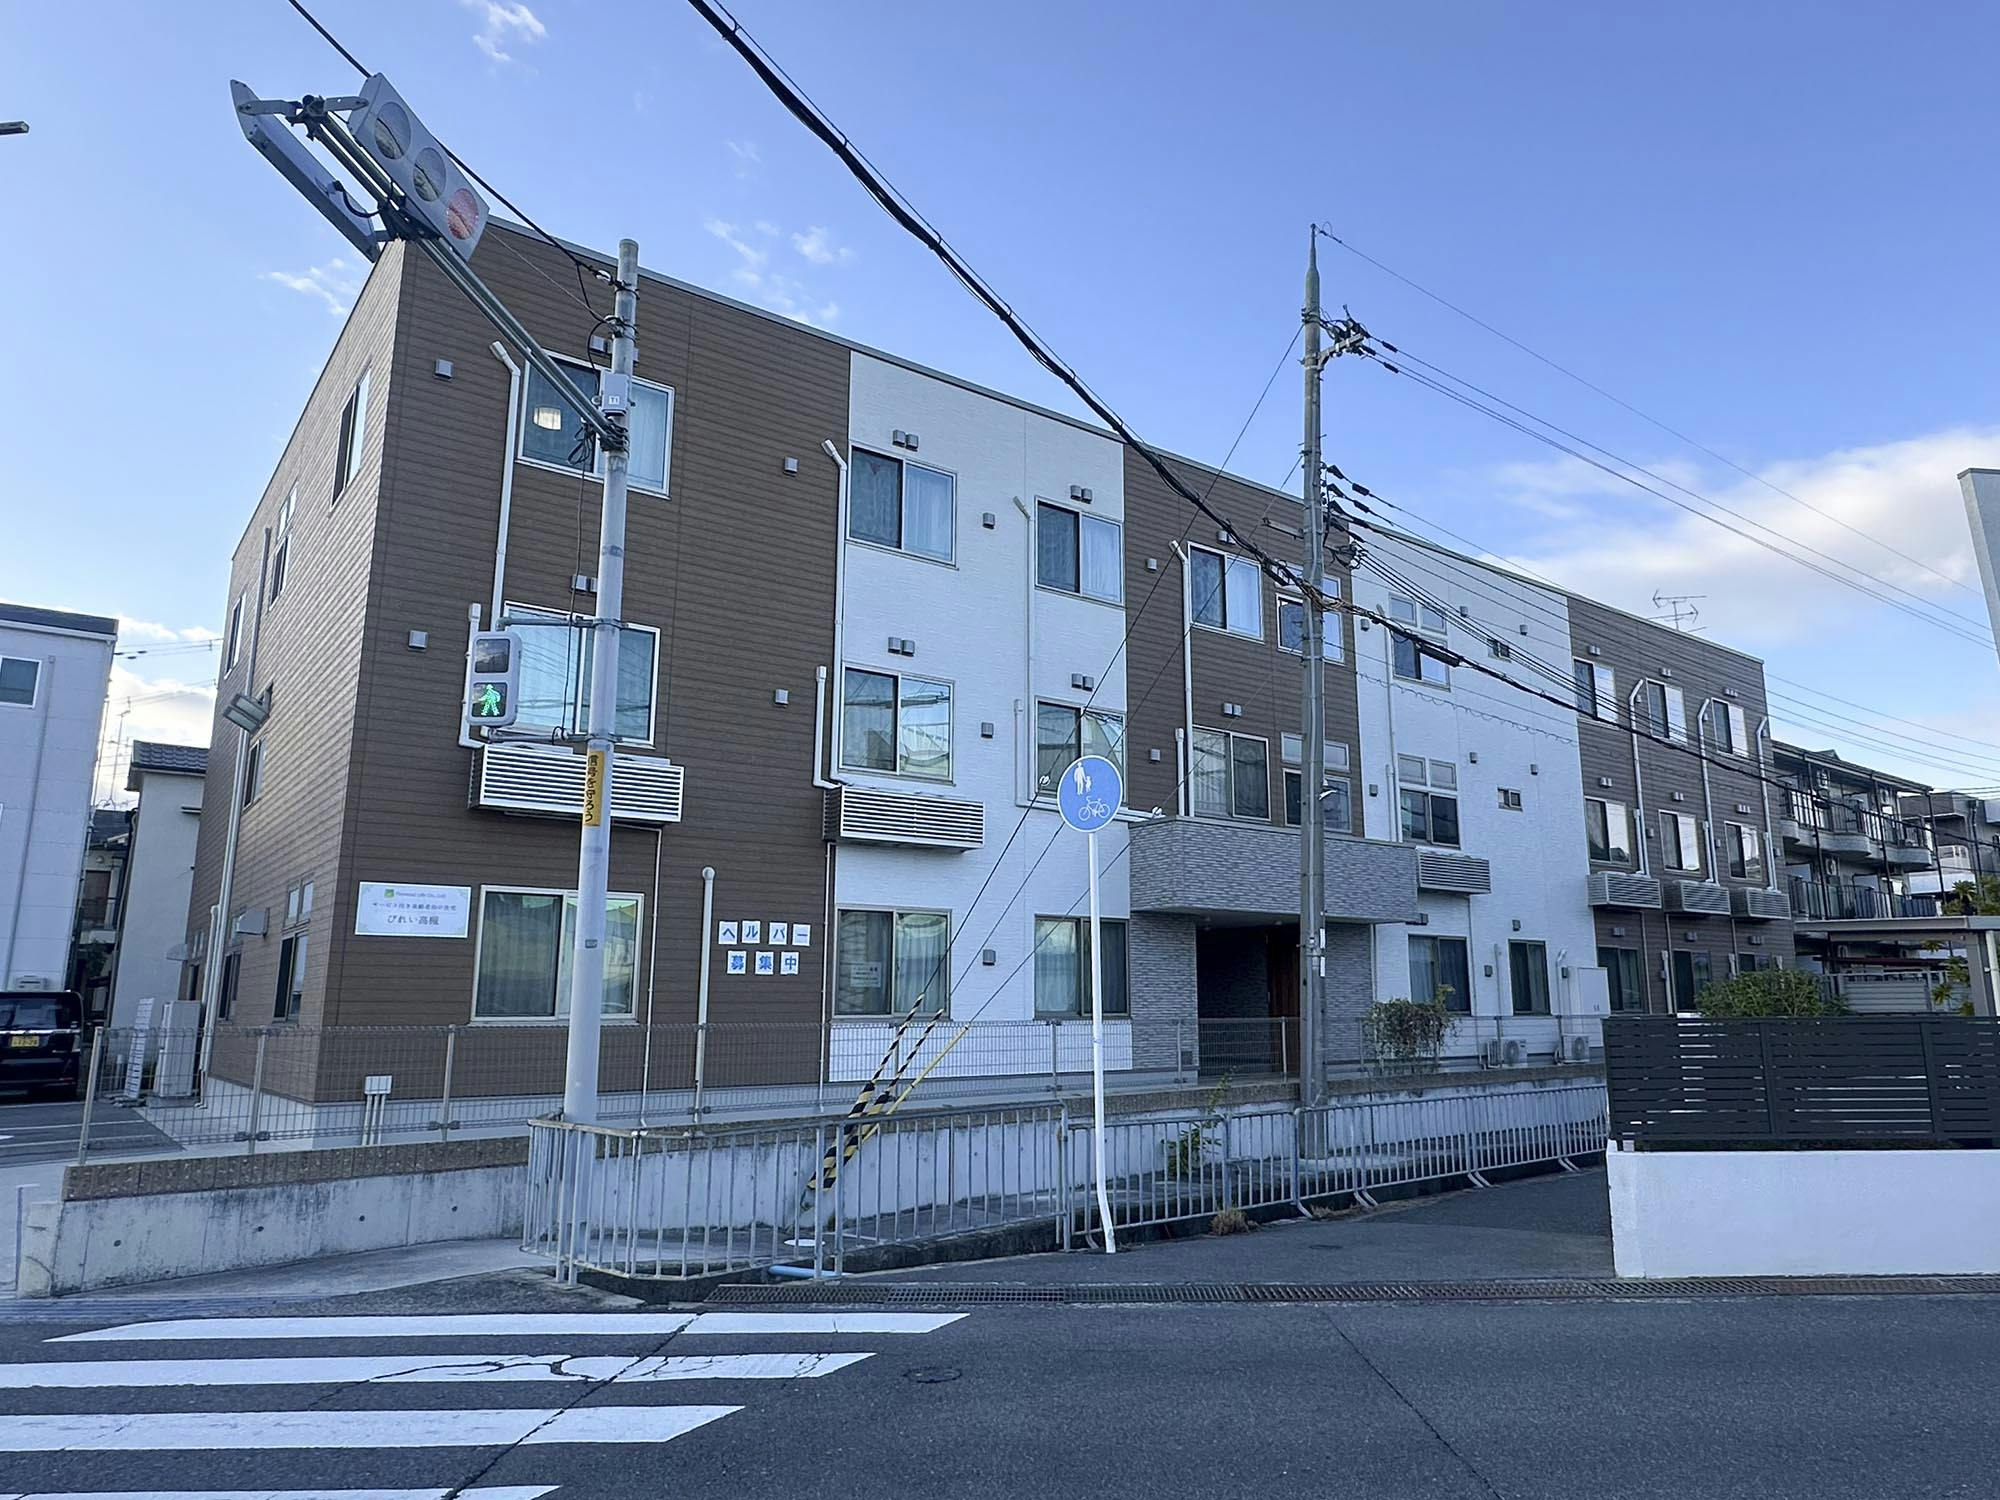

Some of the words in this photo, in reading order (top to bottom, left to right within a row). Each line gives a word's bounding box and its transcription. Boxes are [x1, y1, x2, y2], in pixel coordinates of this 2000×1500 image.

[585, 754, 598, 822] 信号を守ろう
[731, 955, 797, 971] 募集中
